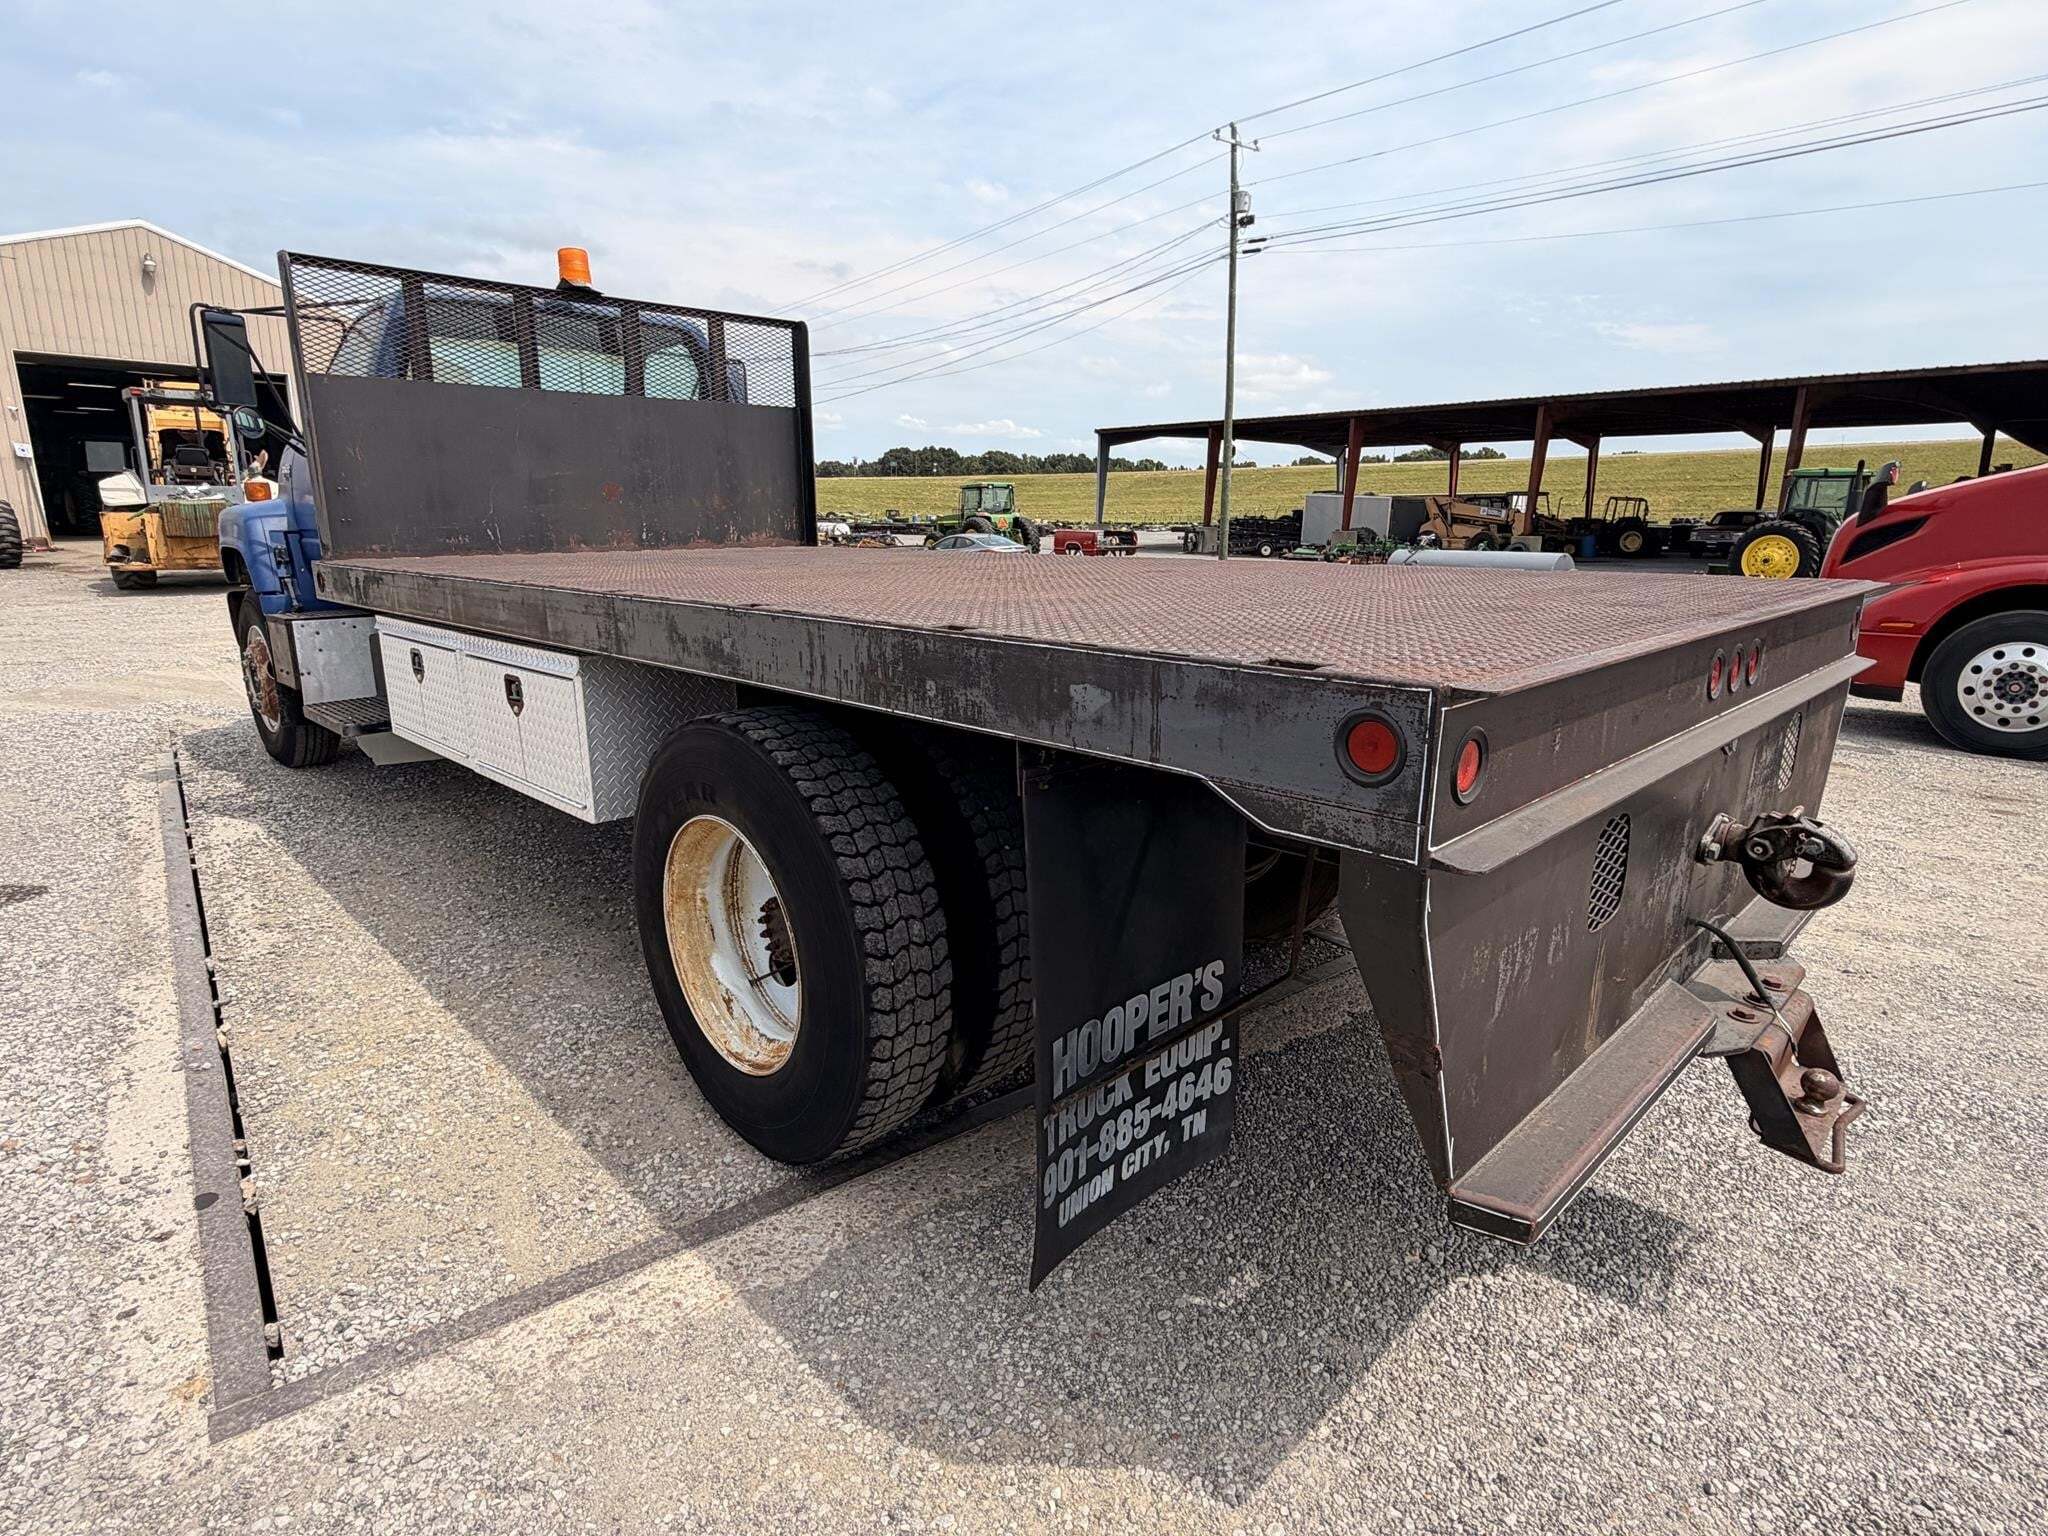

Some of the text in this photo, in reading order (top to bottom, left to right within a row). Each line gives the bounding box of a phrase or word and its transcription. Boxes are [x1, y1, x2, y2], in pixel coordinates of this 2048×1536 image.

[1043, 1019, 1231, 1156] TRUCK EQUIP.
[1052, 960, 1225, 1099] HOOPER'S
[1043, 1056, 1233, 1209] 901-885-4646
[1058, 1108, 1207, 1229] UNION CITY, TN
